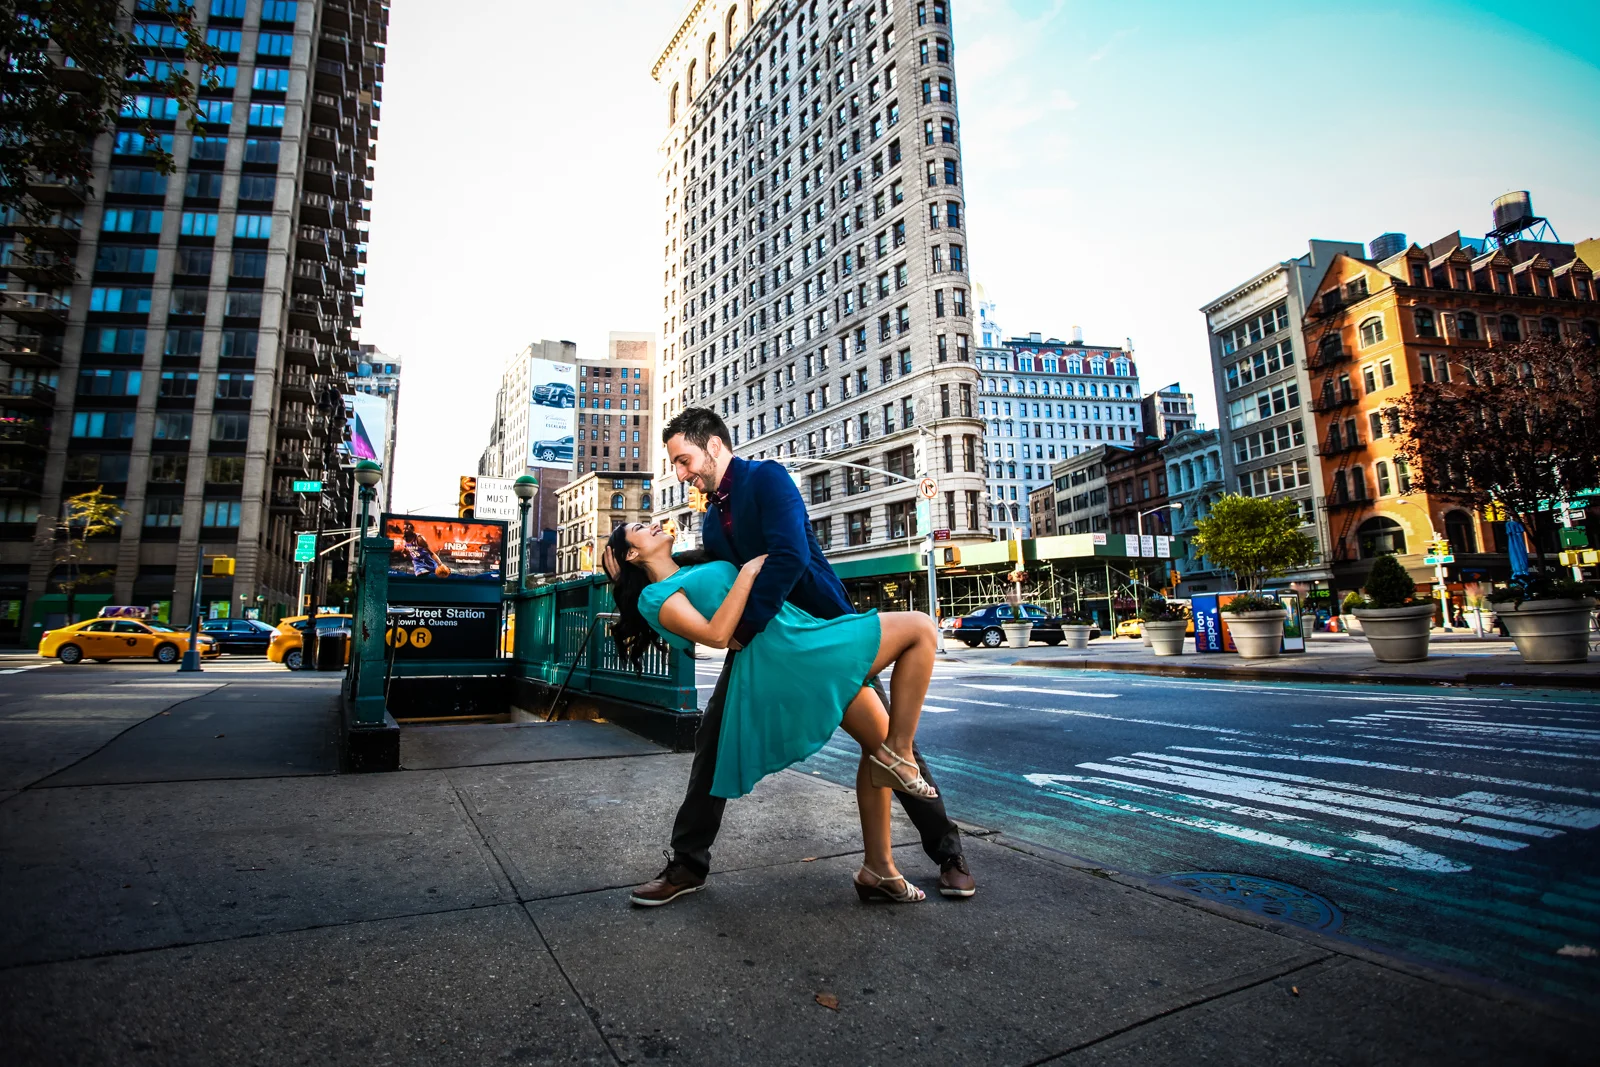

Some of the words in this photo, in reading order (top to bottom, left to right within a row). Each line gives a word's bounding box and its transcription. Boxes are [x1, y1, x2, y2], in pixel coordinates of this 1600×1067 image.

[486, 494, 508, 503] MUST
[479, 506, 497, 514] TURN
[447, 542, 468, 551] NBA
[446, 608, 485, 619] Station
[419, 618, 425, 626] &
[428, 618, 458, 627] Queens
[1196, 611, 1207, 651] flatiron
[1207, 615, 1219, 650] paper
[416, 632, 426, 643] R
